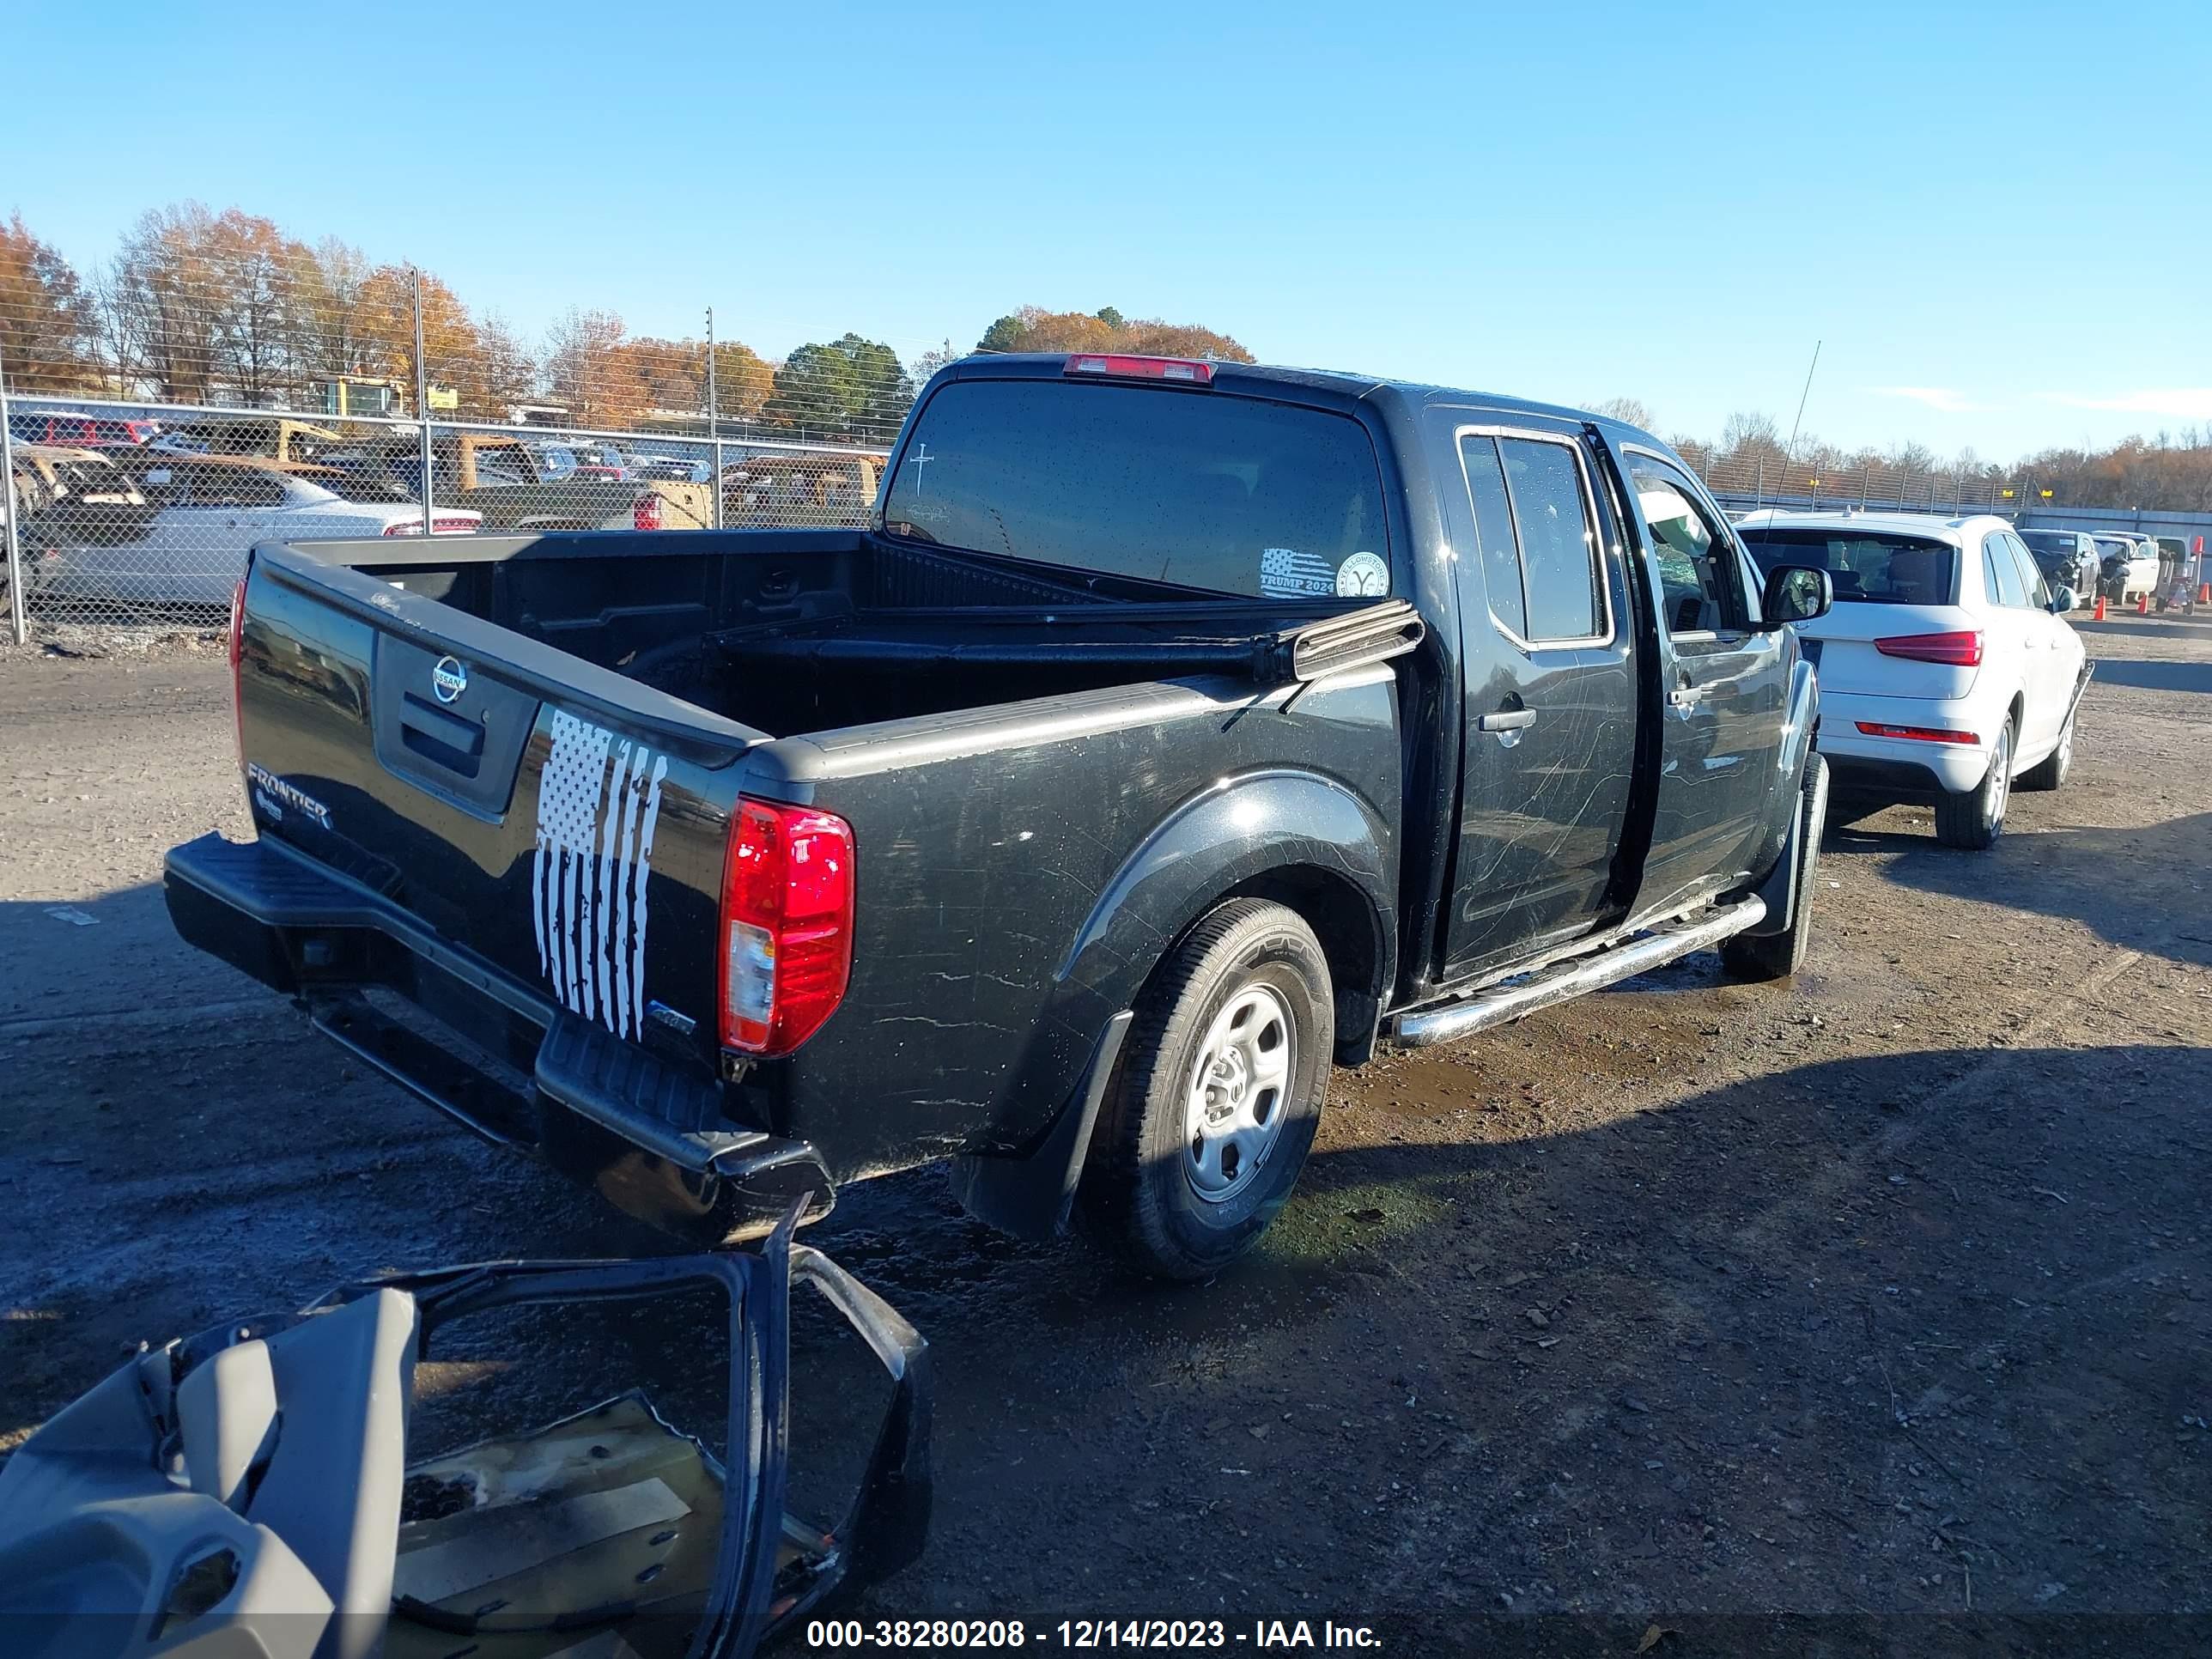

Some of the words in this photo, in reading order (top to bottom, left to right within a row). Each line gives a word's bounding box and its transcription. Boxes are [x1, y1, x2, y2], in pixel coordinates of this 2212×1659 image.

[1340, 556, 1385, 580] YELLOWSTONE
[1260, 574, 1304, 588] TRUMP
[1305, 580, 1334, 593] 2024
[434, 671, 461, 689] NISSAN
[248, 762, 331, 830] FRONTIER
